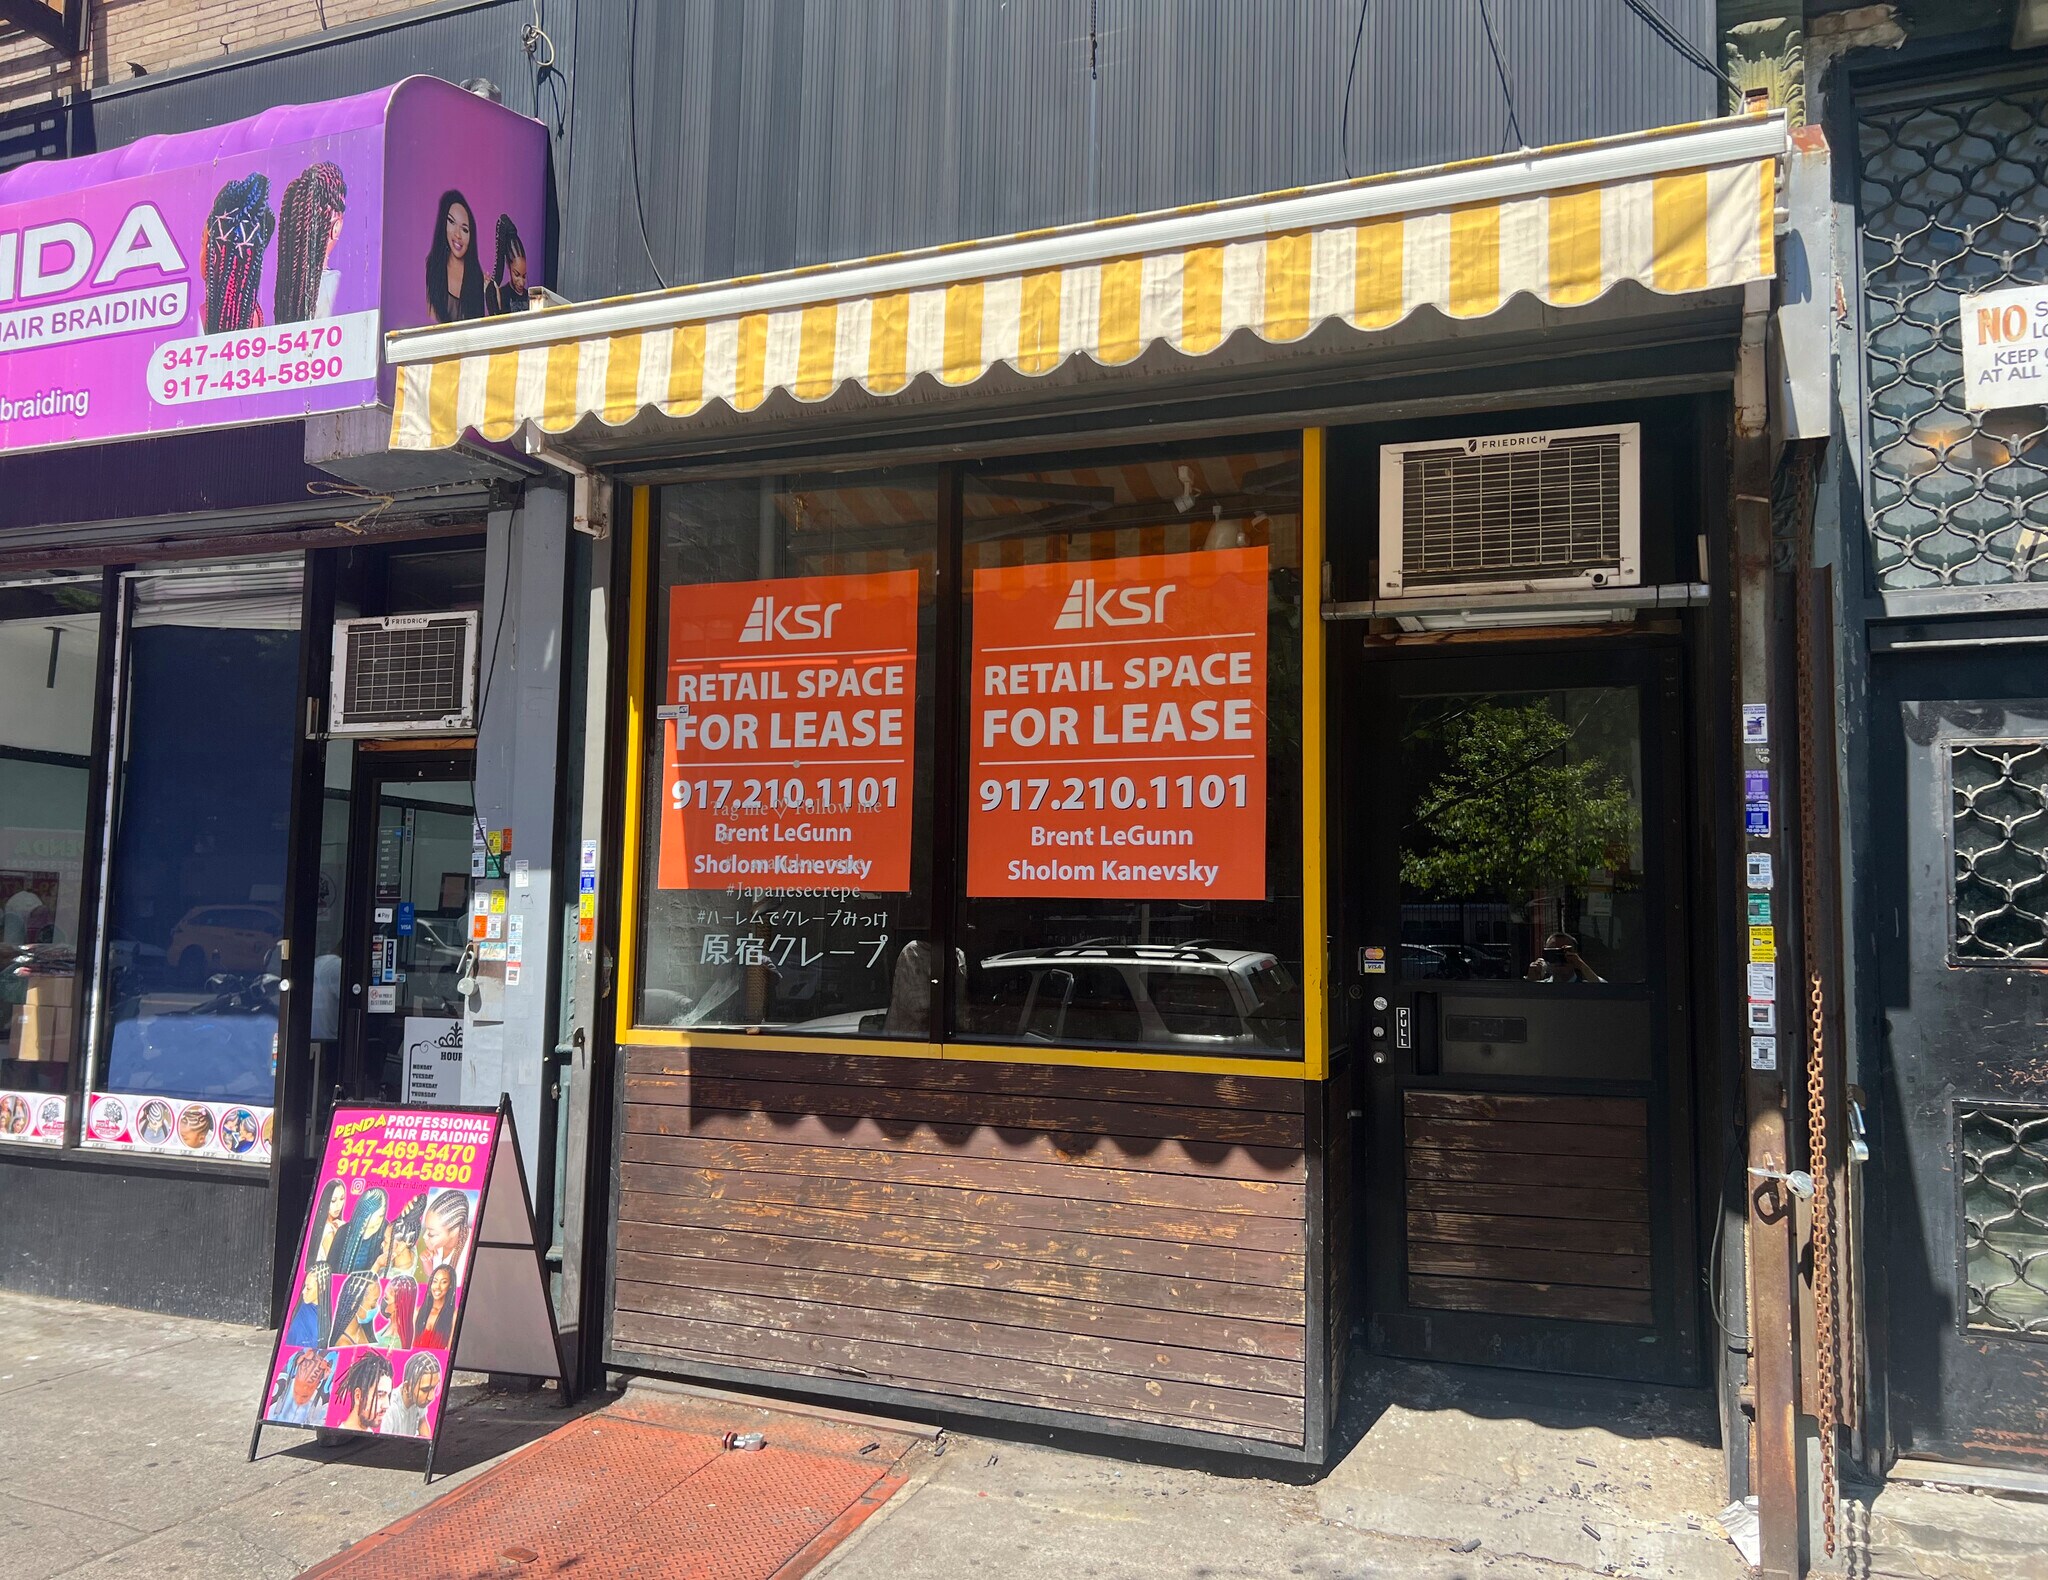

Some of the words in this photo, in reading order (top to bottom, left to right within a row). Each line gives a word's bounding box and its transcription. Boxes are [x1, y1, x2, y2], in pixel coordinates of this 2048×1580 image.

[0, 203, 186, 300] DA
[0, 315, 44, 343] AIR
[51, 294, 179, 334] BRAIDING
[1977, 304, 2028, 345] NO
[163, 325, 343, 370] 347-469-5470
[1995, 349, 2039, 366] KEEP
[163, 357, 343, 400] 917-434-5890
[1978, 368, 2003, 385] AT
[2008, 365, 2042, 381] ALL
[0, 389, 90, 421] braiding
[1482, 435, 1547, 449] FRIEDRICH
[391, 617, 428, 625] FRIEDRICH
[677, 671, 788, 703] RETAIL
[796, 665, 904, 699] SPACE
[983, 660, 1113, 696] RETAIL
[1123, 652, 1252, 689] SPACE
[676, 712, 758, 750] FOR
[769, 708, 903, 748] LEASE
[983, 707, 1079, 748] FOR
[1093, 699, 1252, 745] LEASE
[671, 776, 898, 811] 917.210.1101
[979, 774, 1247, 811] 917.210.1101
[715, 823, 768, 842] Brent
[774, 823, 852, 842] LeGunn
[1031, 826, 1094, 846] Brent
[1100, 825, 1194, 846] LeGunn
[694, 854, 769, 874] Sholom
[774, 854, 872, 880] Kanevsky
[1007, 860, 1095, 881] Sholom
[1102, 860, 1219, 887] Kanevsky
[726, 881, 861, 903] #Japanesecrepe
[697, 909, 889, 928] #ハーレムでクレープみっけ
[699, 932, 889, 968] 原宿クレープ
[334, 1113, 387, 1138] PENDA
[388, 1114, 491, 1132] PROFESSIONAL
[384, 1128, 417, 1141] HAIR
[420, 1129, 488, 1145] BRAIDING
[341, 1138, 476, 1164] 347-469-5470
[336, 1157, 472, 1184] 917-434-5890
